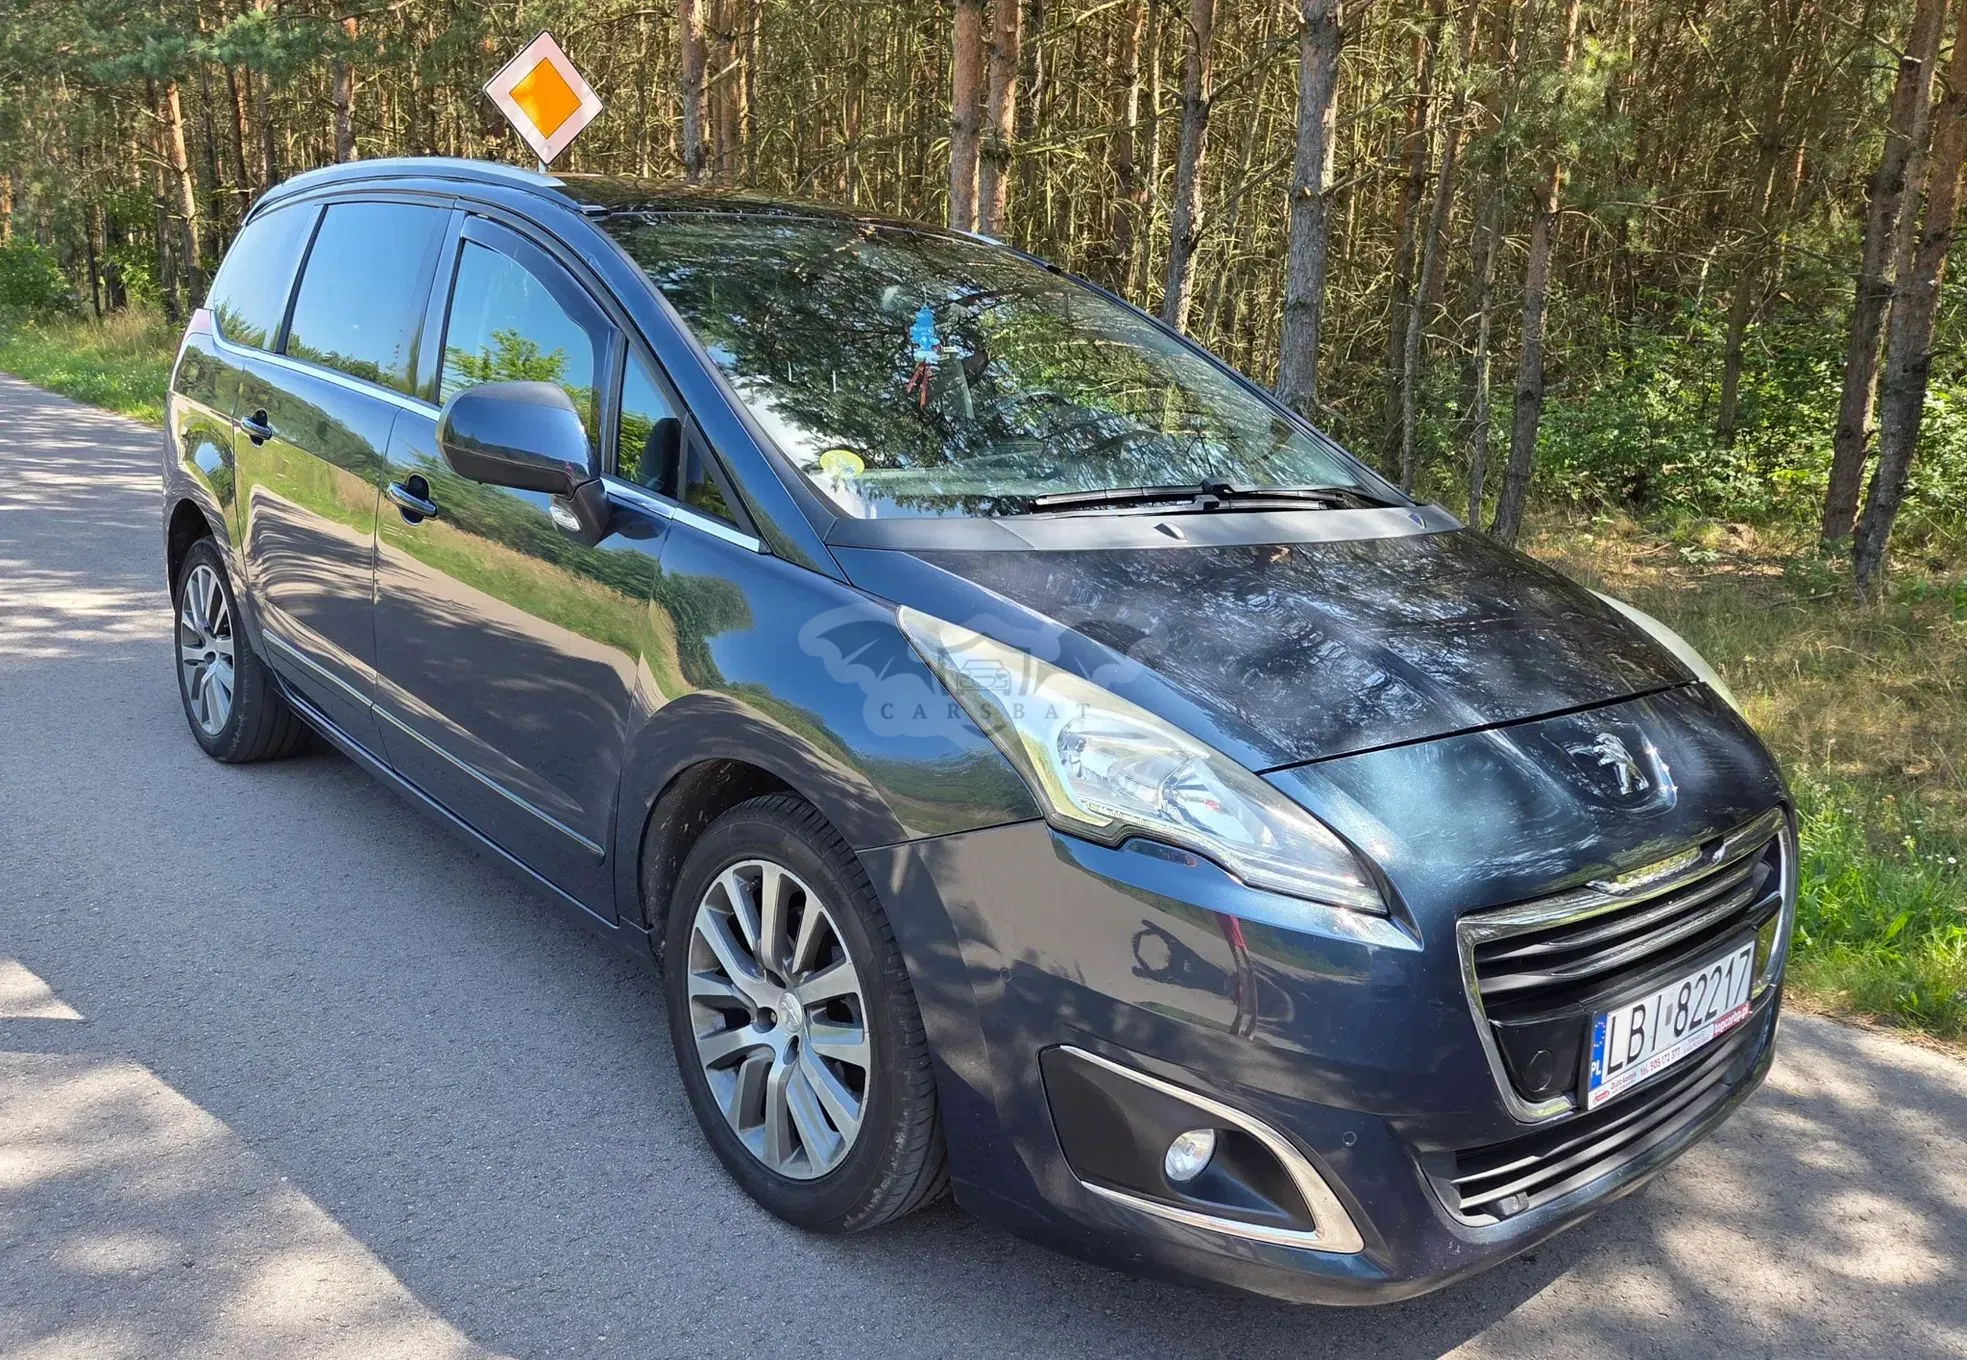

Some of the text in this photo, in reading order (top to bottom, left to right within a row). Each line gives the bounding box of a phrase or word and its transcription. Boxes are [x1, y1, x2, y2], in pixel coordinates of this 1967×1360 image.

[1606, 947, 1752, 1076] LBI 82217
[1590, 1060, 1602, 1078] PL
